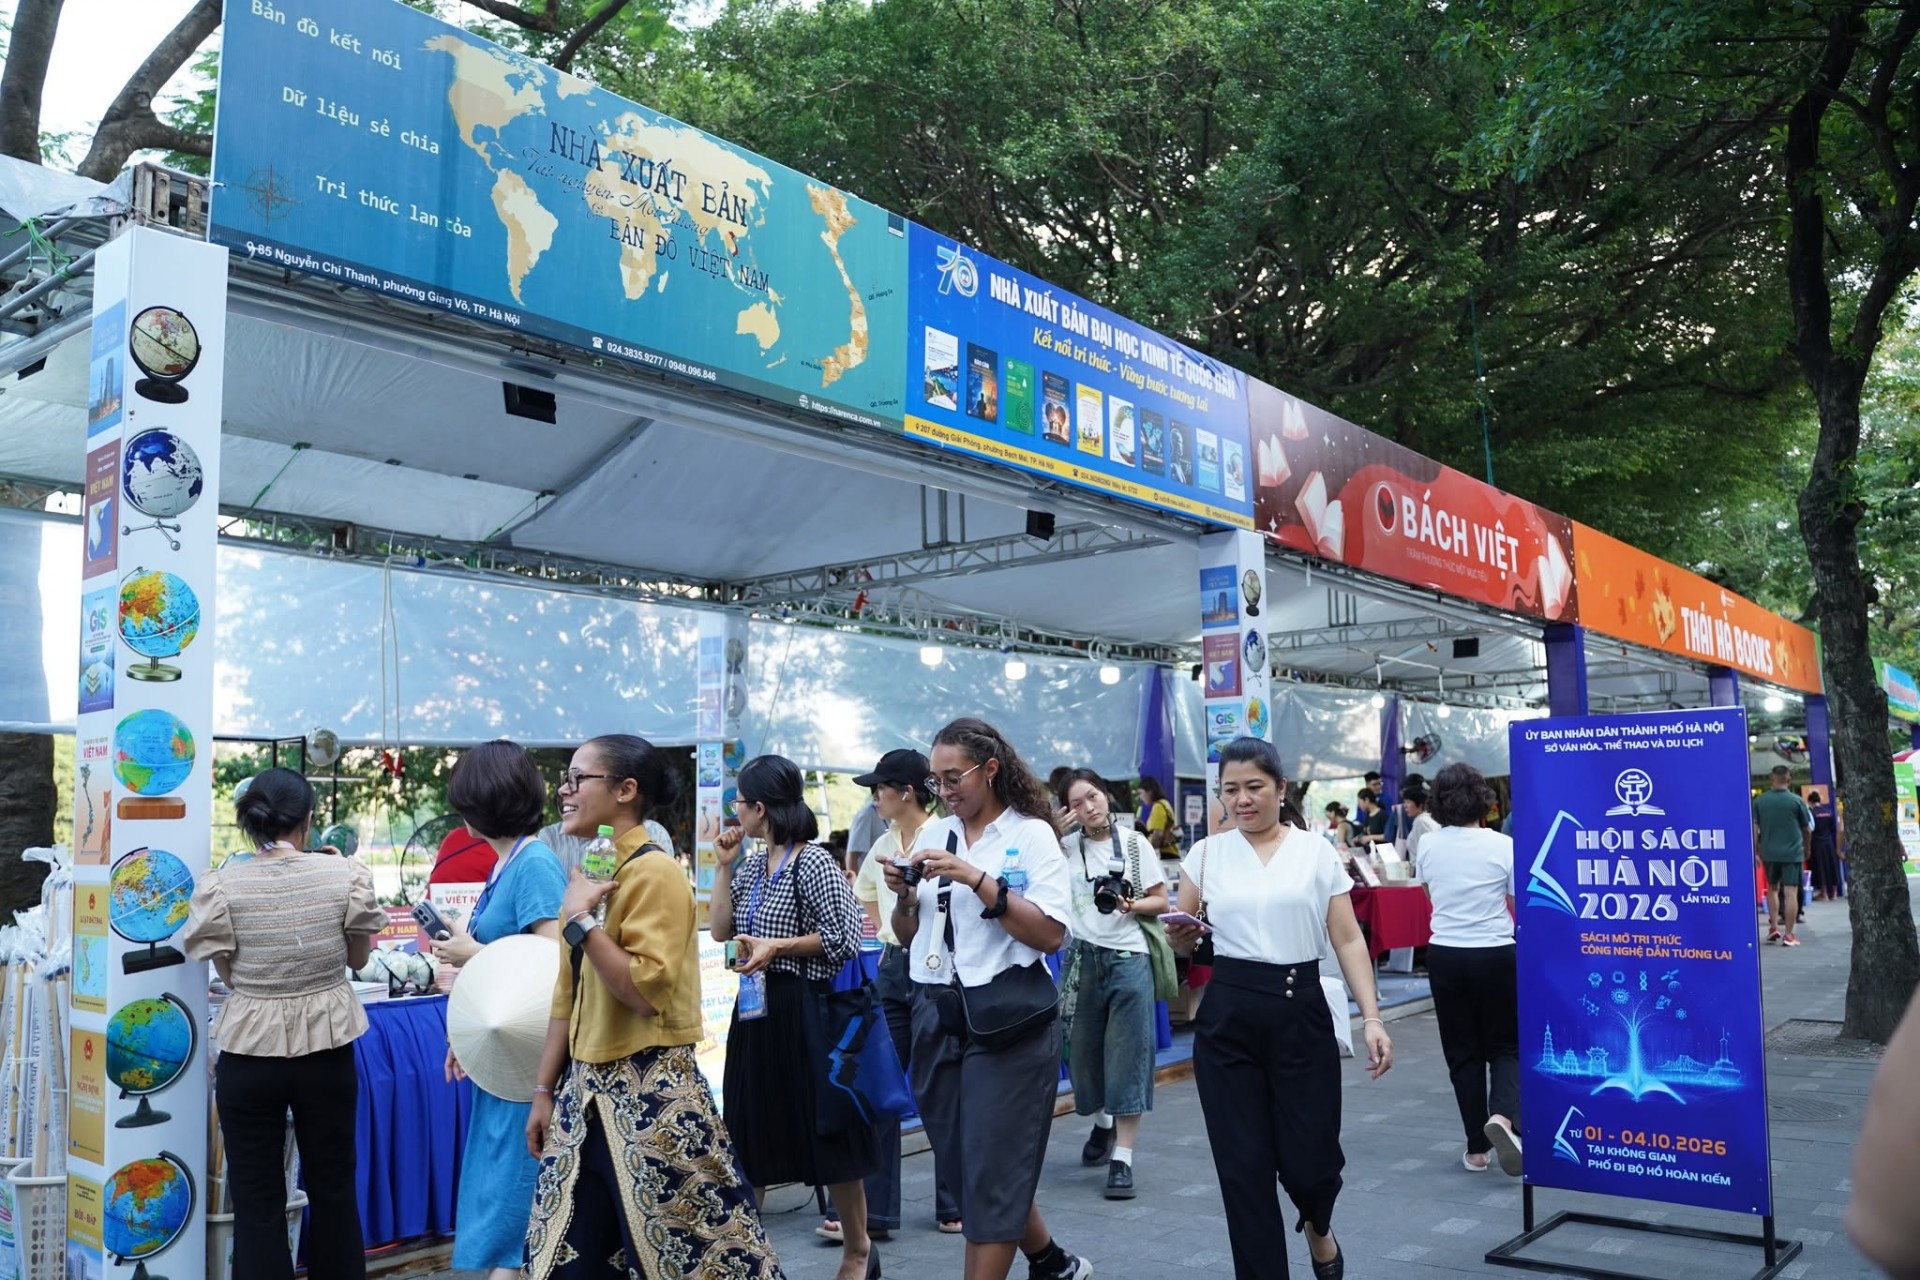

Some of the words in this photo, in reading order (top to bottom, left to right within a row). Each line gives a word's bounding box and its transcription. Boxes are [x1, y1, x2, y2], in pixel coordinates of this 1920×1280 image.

[252, 0, 286, 25] Bản
[297, 17, 319, 37] đồ
[330, 28, 361, 54] kết
[372, 46, 402, 71] nối
[283, 86, 305, 107] Dữ
[317, 98, 359, 127] liệu
[370, 117, 390, 138] sẻ
[400, 131, 440, 155] chia
[550, 121, 604, 172] NHÀ
[620, 150, 687, 203] XUẤT
[701, 181, 747, 227] BẢN
[316, 175, 347, 199] Tri
[359, 189, 399, 215] thức
[410, 205, 439, 228] lan
[445, 215, 471, 238] tỏa
[609, 217, 644, 250] BẢN
[655, 228, 678, 260] ĐỒ
[689, 245, 730, 281] VIỆT
[739, 264, 770, 294] NAM
[257, 244, 272, 257] 85
[274, 247, 320, 272] Nguyễn
[322, 260, 342, 276] Chí
[344, 266, 381, 288] Thanh,
[383, 278, 426, 301] phường
[454, 298, 471, 313] Võ,
[473, 303, 487, 317] TP.
[489, 308, 503, 321] Hà
[504, 312, 521, 327] Nội
[990, 272, 1021, 309] NHÀ
[1023, 287, 1059, 324] XUẤT
[1061, 301, 1089, 338] BẢN
[1091, 317, 1112, 351] ĐẠI
[1114, 328, 1139, 360] HỌC
[1141, 340, 1169, 371] KINH
[1169, 351, 1185, 378] TẾ
[1185, 360, 1214, 391] QUỐC
[607, 341, 663, 368] 024.3835.9277
[668, 359, 717, 382] 0948.096.846
[1033, 326, 1053, 350] Kết
[1074, 346, 1088, 364] tri
[1088, 351, 1112, 374] thức
[1119, 362, 1145, 390] Vững
[1146, 374, 1168, 396] bước
[1170, 384, 1196, 411] tương
[1197, 395, 1209, 412] lai
[811, 401, 882, 428] https://narenca.com.vn
[920, 424, 931, 434] 207
[950, 433, 962, 444] Giải
[1401, 489, 1469, 557] BÁCH
[1474, 520, 1519, 580] VIỆT
[89, 607, 108, 632] GIS
[1680, 601, 1715, 656] THÁI
[1715, 611, 1733, 661] HÀ
[1733, 625, 1774, 675] BOOKS
[1215, 712, 1236, 726] GIS
[1525, 731, 1540, 740] ỦY
[1541, 730, 1563, 740] BAN
[1564, 727, 1594, 739] NHÂN
[1596, 726, 1619, 737] DÂN
[1620, 725, 1658, 736] THÀNH
[1660, 721, 1684, 734] PHỐ
[1685, 722, 1701, 733] HÀ
[1704, 721, 1724, 734] NỘI
[1545, 744, 1558, 753] SỞ
[1559, 742, 1579, 752] VĂN
[1604, 739, 1622, 750] THỂ
[1624, 740, 1649, 750] THAO
[1651, 739, 1665, 749] VÀ
[1666, 739, 1680, 748] DU
[1682, 738, 1704, 749] LỊCH
[1575, 827, 1634, 853] HỘI
[1641, 827, 1726, 850] SÁCH
[1577, 855, 1641, 886] HÀ
[1649, 855, 1729, 891] NỘI
[445, 896, 468, 905] VIỆT
[1579, 893, 1679, 921] 2026
[1681, 893, 1699, 904] LẦN
[1701, 894, 1720, 904] THỨ
[1721, 896, 1731, 904] XI
[397, 925, 418, 935] NAM
[1581, 932, 1609, 943] SÁCH
[1612, 933, 1630, 944] MỞ
[1632, 934, 1650, 945] TRI
[1652, 932, 1682, 945] THỨC
[1581, 943, 1612, 955] CÔNG
[1613, 944, 1643, 959] NGHỆ
[1646, 944, 1671, 957] DẪN
[1673, 948, 1712, 959] TƯƠNG
[1714, 950, 1732, 960] LAI
[1569, 1127, 1583, 1139] TỪ
[1584, 1125, 1603, 1141] 01
[1621, 1129, 1727, 1156] 04.10.2026
[1587, 1143, 1605, 1155] TẠI
[1607, 1145, 1646, 1160] KHÔNG
[1648, 1152, 1676, 1163] GIAN
[1588, 1157, 1611, 1170] PHỐ
[1613, 1161, 1626, 1172] ĐI
[1627, 1161, 1645, 1177] BỘ
[1646, 1161, 1664, 1177] HỒ
[1665, 1165, 1699, 1182] HOÀN
[1701, 1169, 1731, 1186] KIẾM
